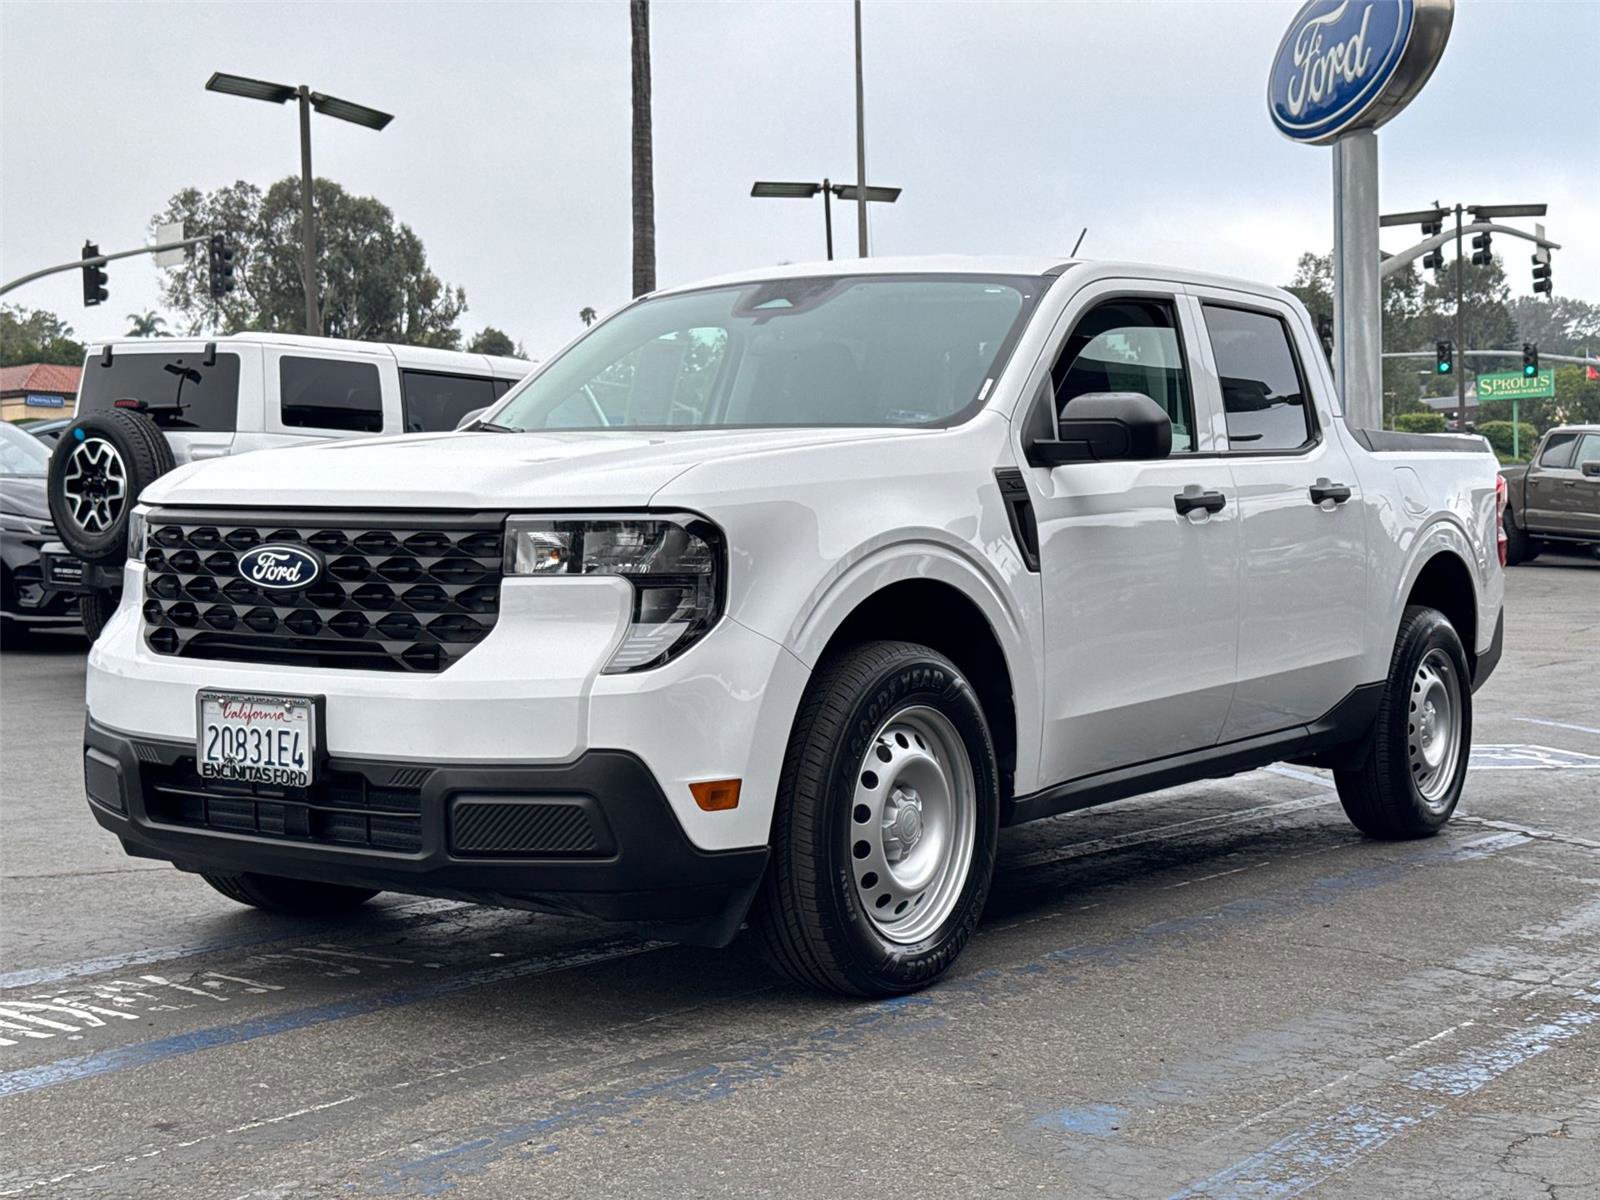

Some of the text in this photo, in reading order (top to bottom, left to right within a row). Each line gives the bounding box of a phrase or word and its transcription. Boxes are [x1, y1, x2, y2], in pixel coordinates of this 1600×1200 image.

[1287, 0, 1374, 117] Ford
[252, 552, 303, 582] Ford
[223, 700, 292, 726] California
[207, 725, 305, 769] 20831E4
[202, 763, 308, 787] ENCINITAS FORD
